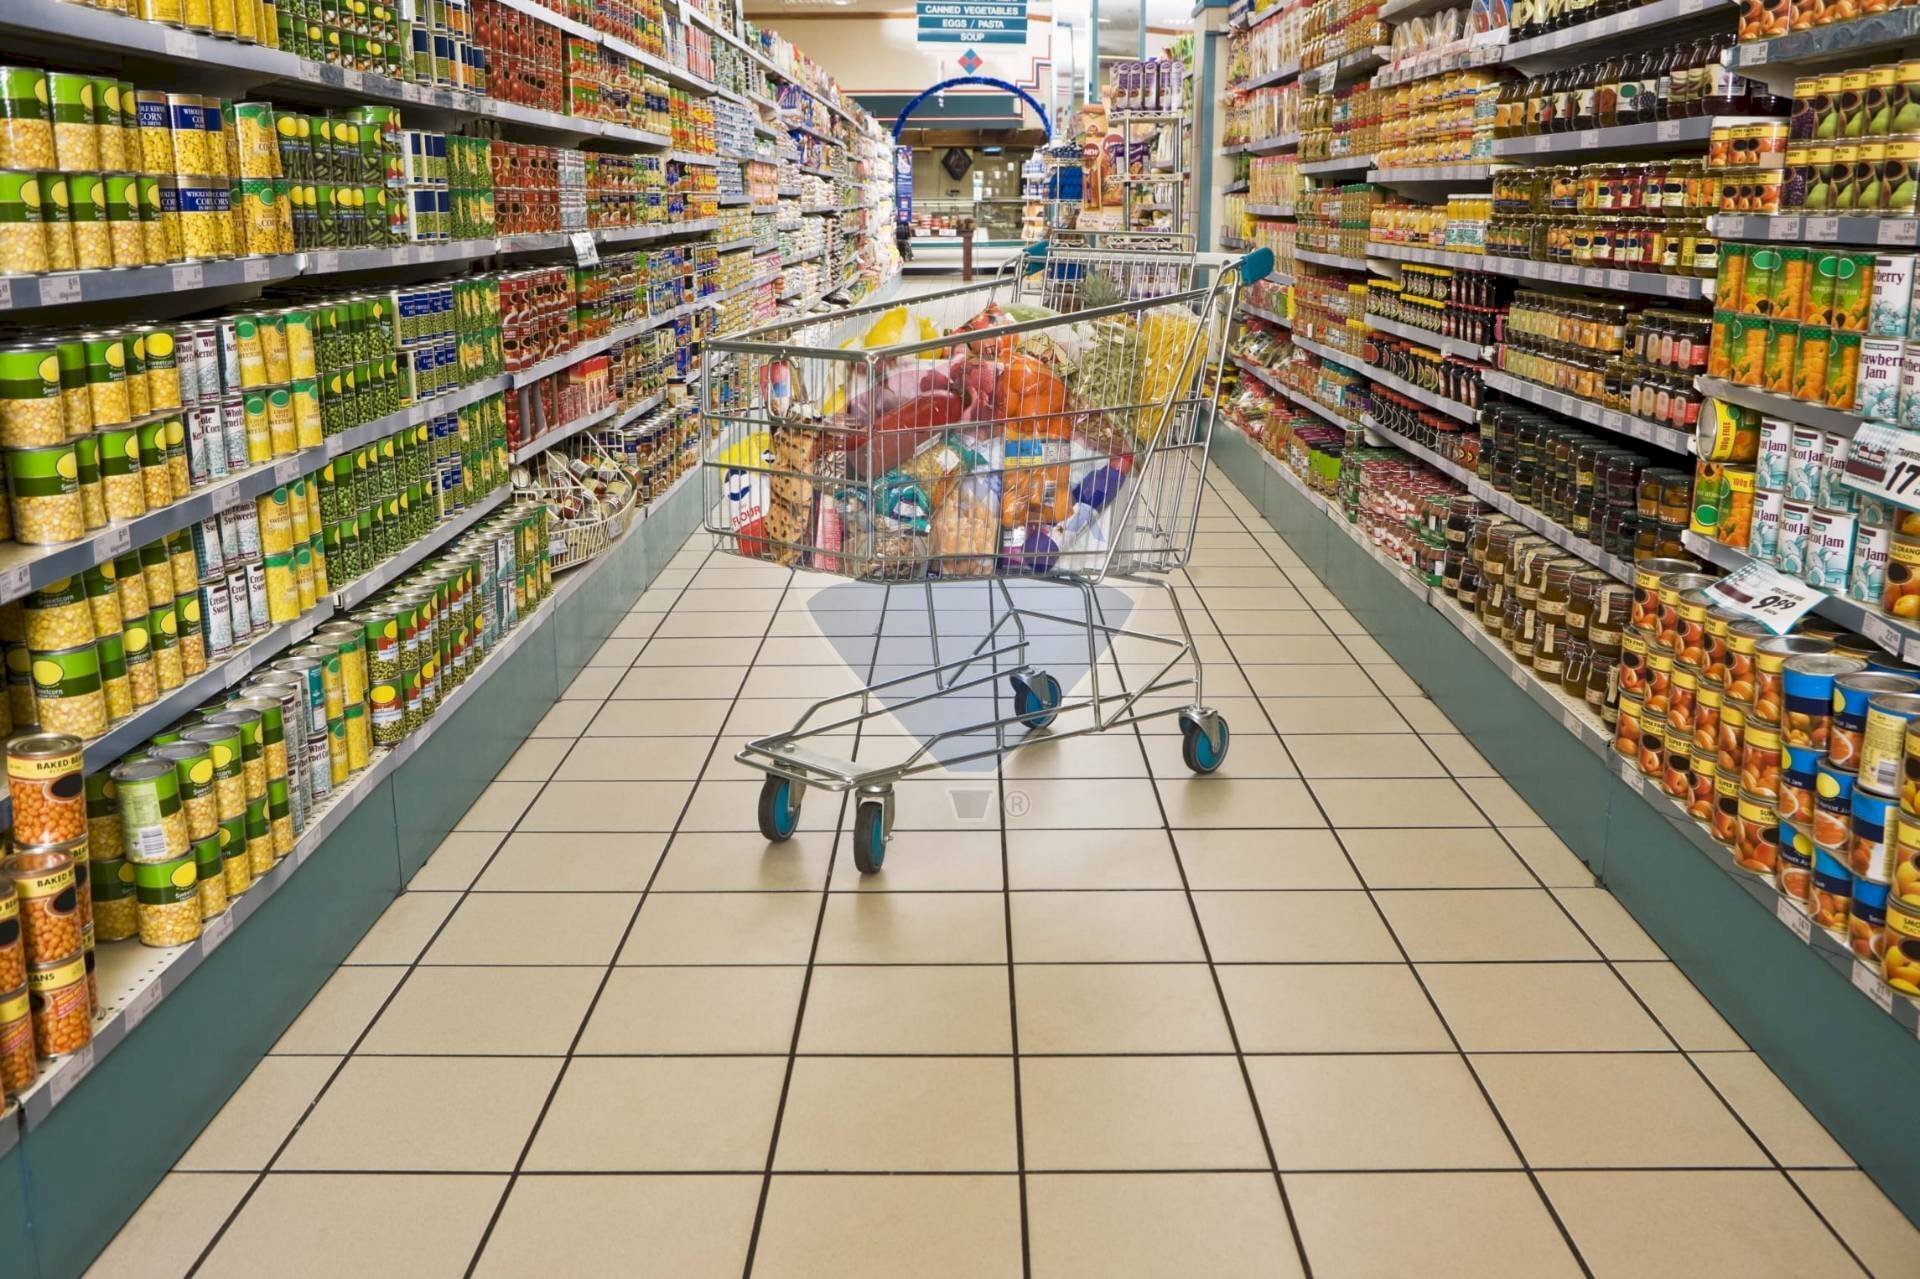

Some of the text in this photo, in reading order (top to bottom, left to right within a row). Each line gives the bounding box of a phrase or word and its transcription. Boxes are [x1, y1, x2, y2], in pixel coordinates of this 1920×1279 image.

[925, 5, 1018, 15] CANNED VEGETABLES
[942, 19, 1004, 29] EGGS / PASTA
[960, 33, 984, 41] SOUP
[1865, 366, 1887, 380] Jam
[1768, 440, 1787, 452] Jam
[732, 505, 761, 526] FLOUR
[1760, 510, 1779, 522] Jam
[1822, 534, 1844, 548] Jam
[1866, 547, 1888, 562] Jam
[37, 759, 69, 771] BAKED
[37, 874, 67, 887] BAKED
